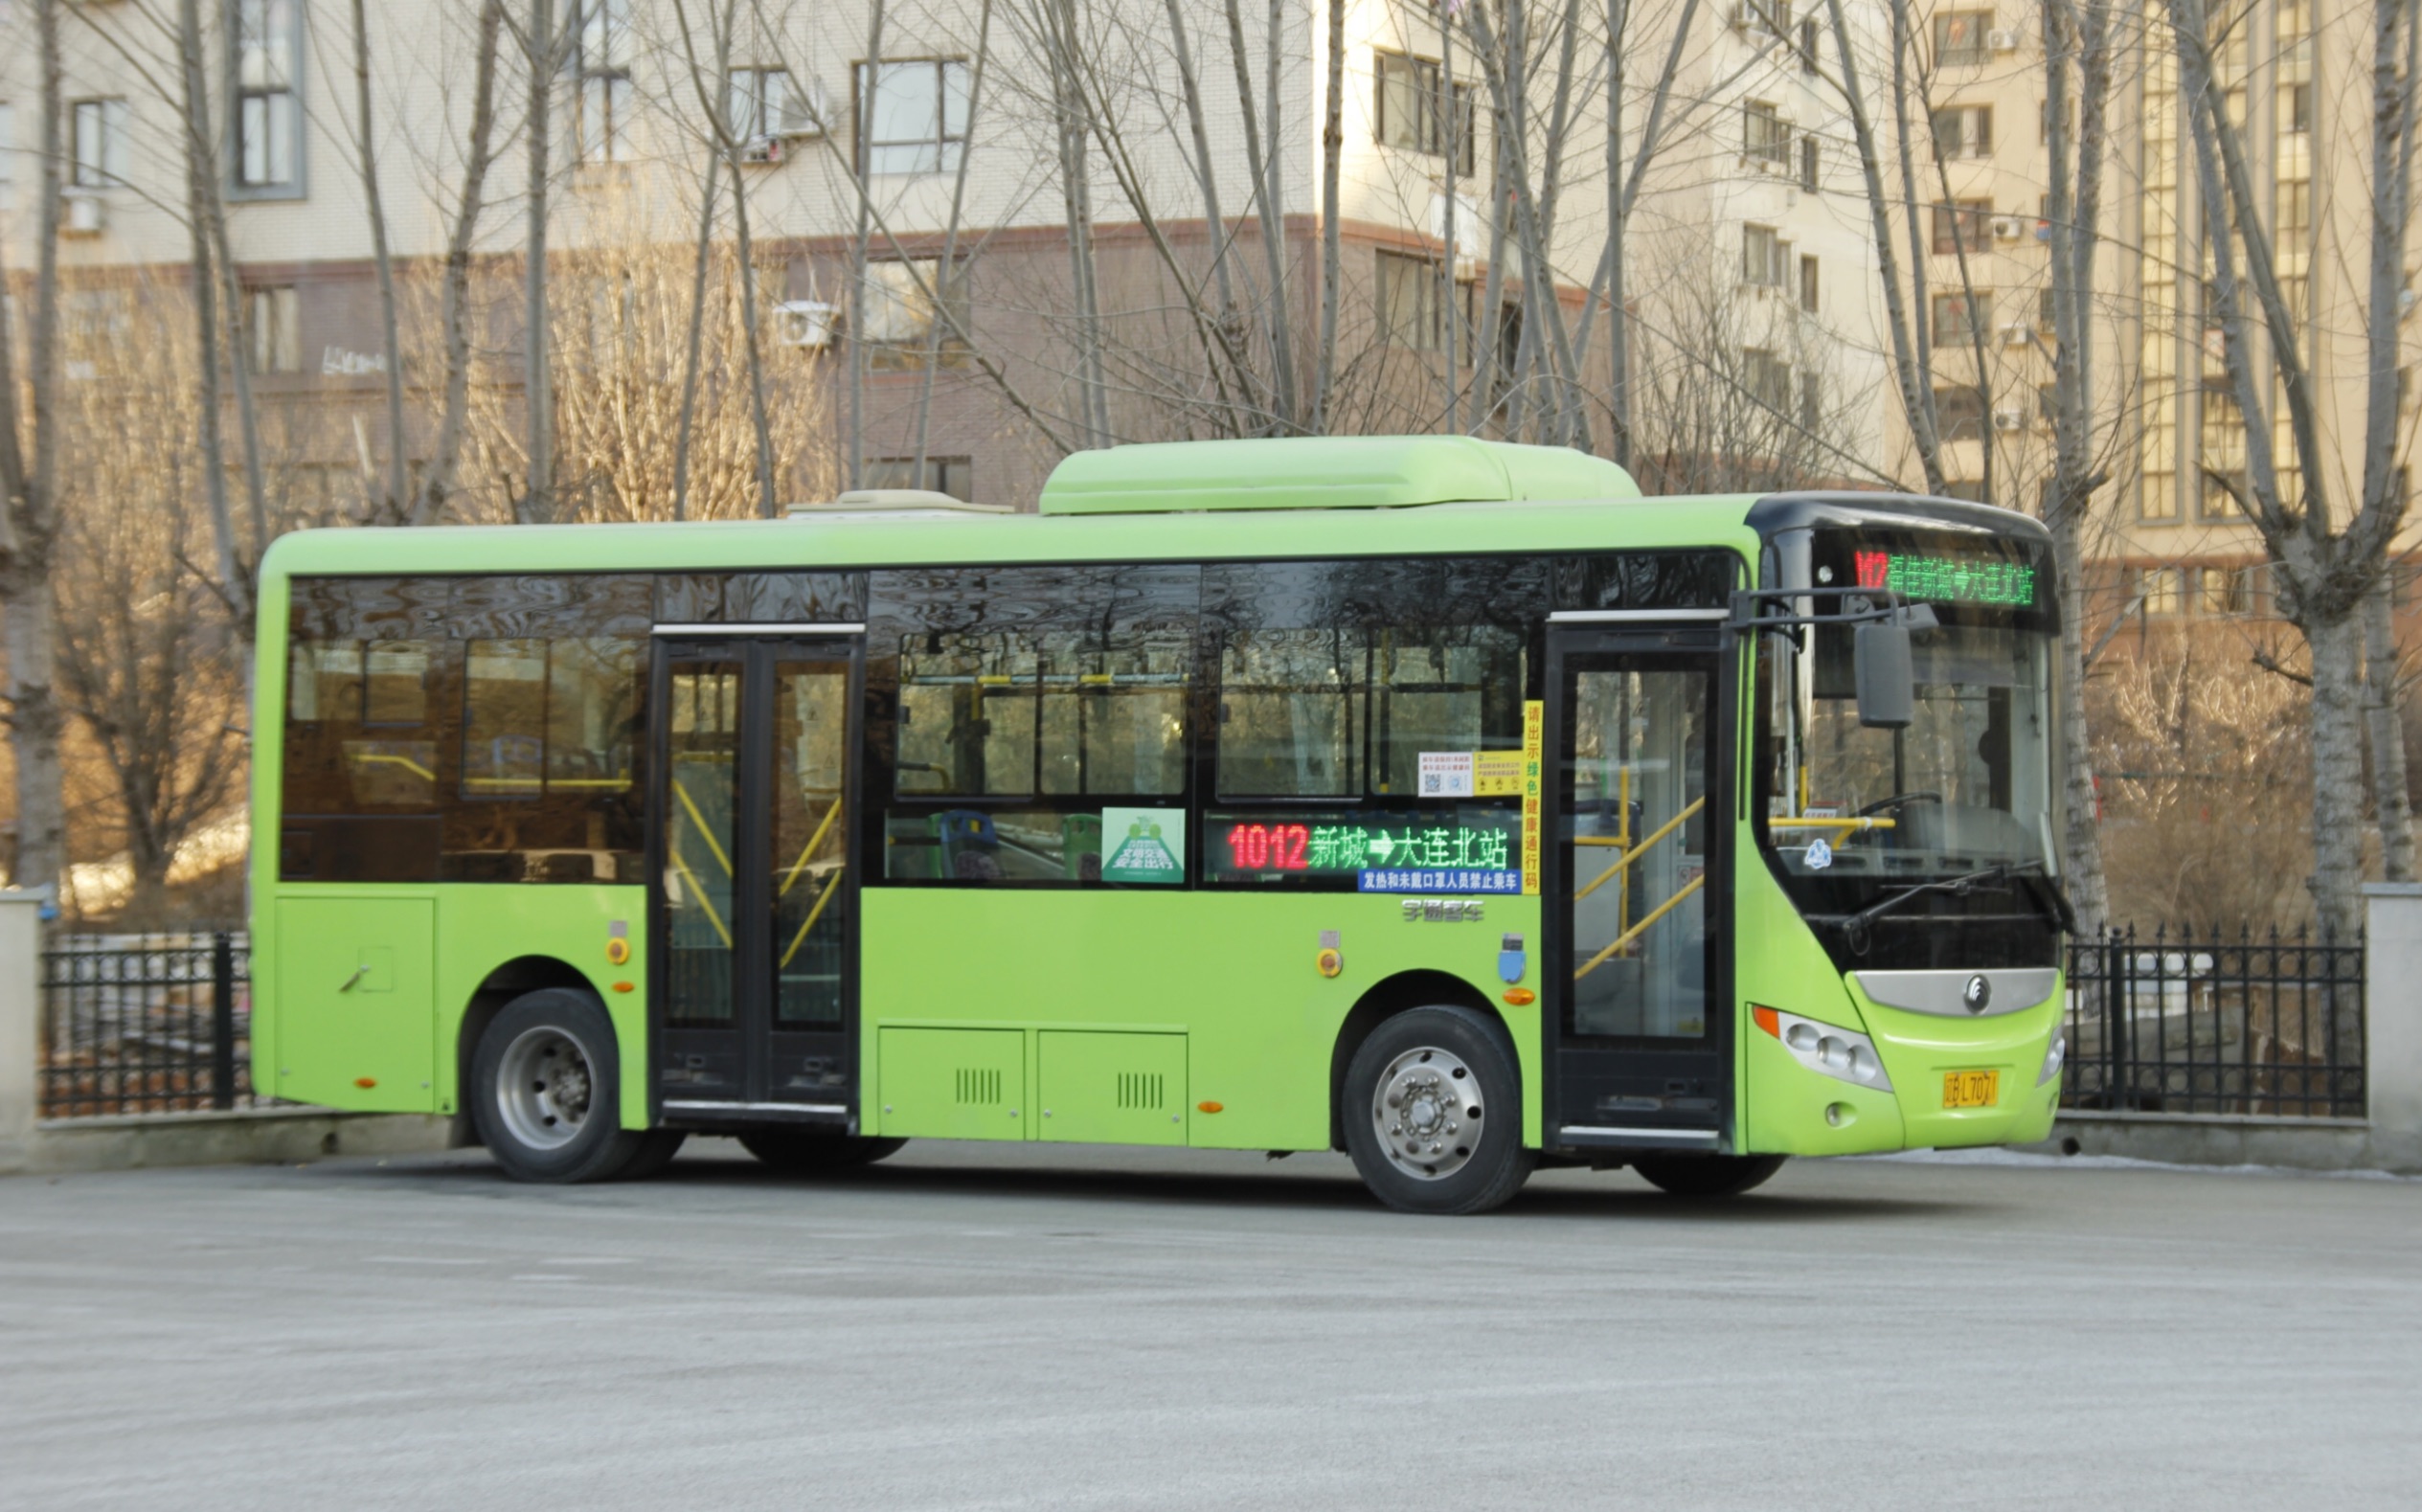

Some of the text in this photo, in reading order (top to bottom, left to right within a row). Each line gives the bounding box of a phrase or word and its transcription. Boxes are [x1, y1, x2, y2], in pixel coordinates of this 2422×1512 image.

[1969, 561, 2034, 604] 大连北站
[1525, 706, 1541, 890] 请出示绿色健康通行码
[1112, 857, 1173, 869] 安全出行
[1229, 824, 1507, 870] 1012 新城 大连北站
[1364, 871, 1516, 891] 发热和未戴口罩人员禁止乘车
